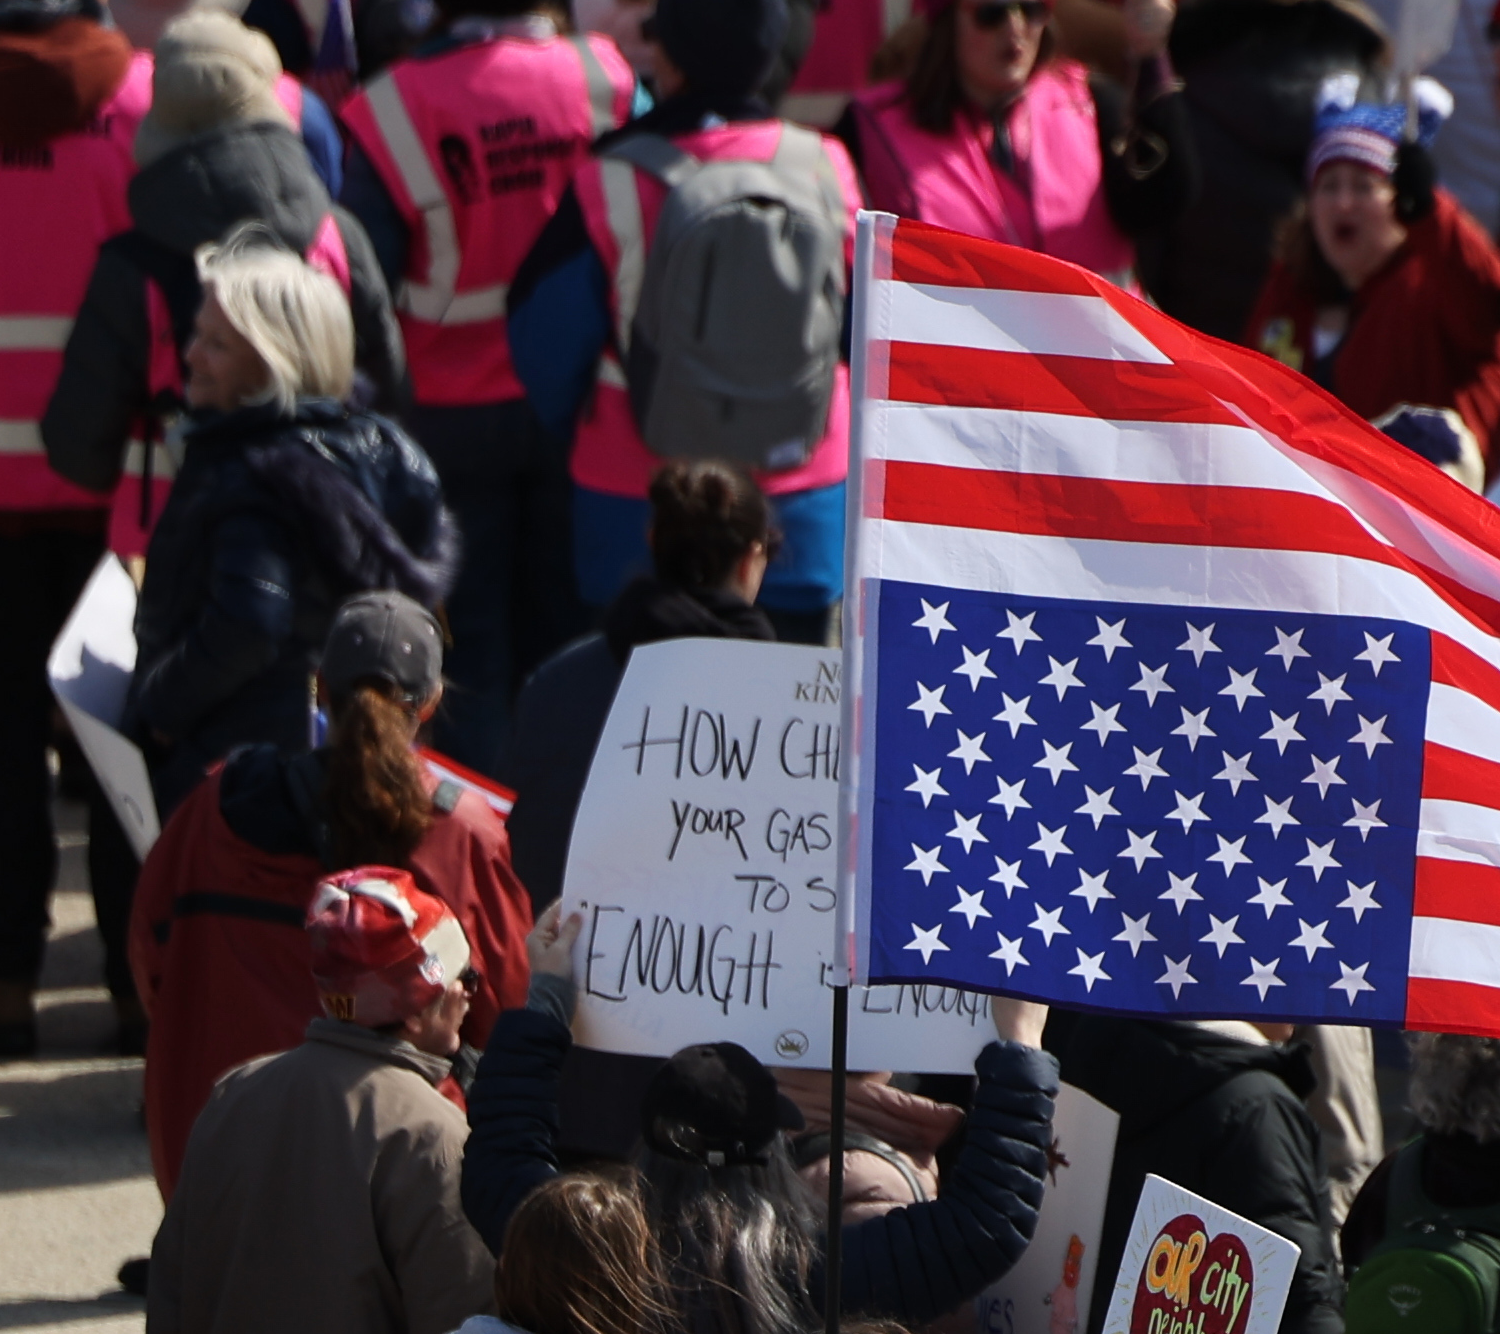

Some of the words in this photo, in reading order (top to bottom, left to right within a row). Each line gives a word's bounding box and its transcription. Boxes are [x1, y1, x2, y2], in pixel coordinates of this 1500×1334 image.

[622, 703, 761, 781] HOW
[669, 798, 747, 861] YOUR
[766, 813, 831, 863] GAS
[735, 874, 790, 913] TO
[1146, 1232, 1206, 1308] OUR
